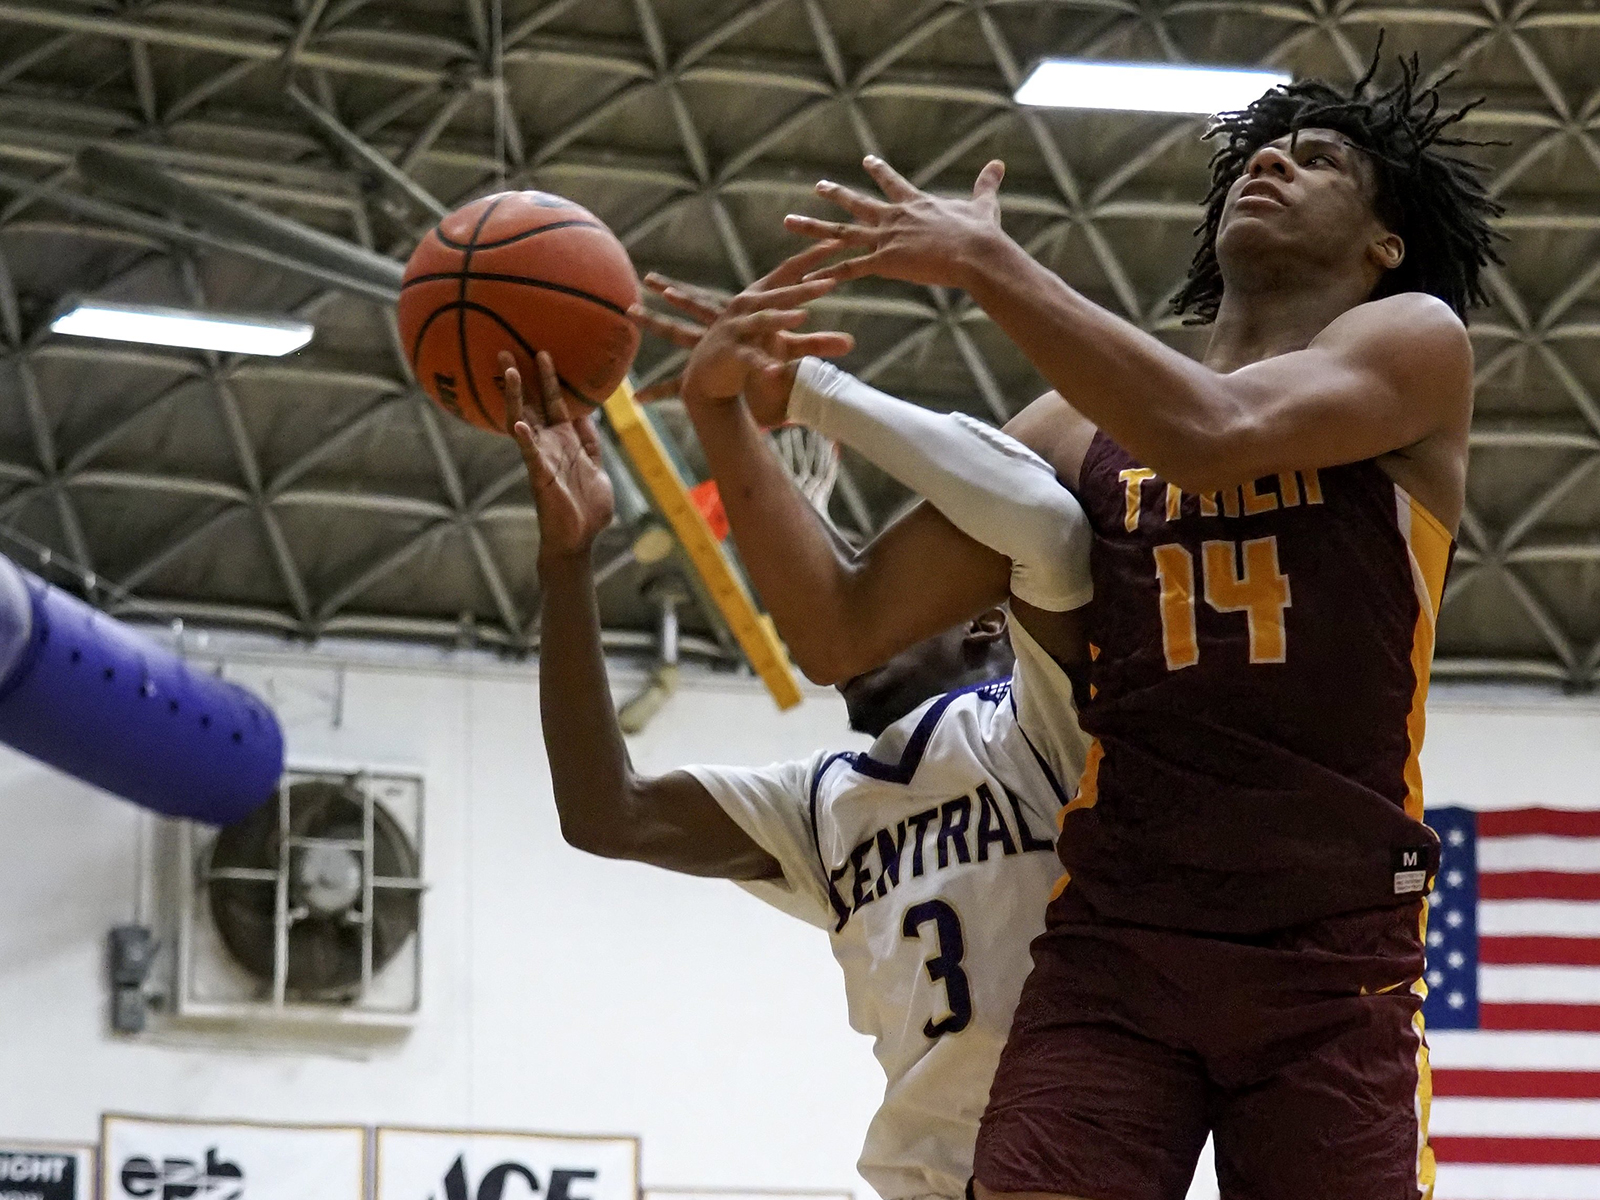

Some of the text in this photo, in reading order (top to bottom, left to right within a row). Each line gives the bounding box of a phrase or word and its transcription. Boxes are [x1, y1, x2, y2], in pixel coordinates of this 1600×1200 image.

[1153, 535, 1292, 671] 14
[828, 781, 1056, 933] CENTRAL
[1403, 851, 1418, 867] M
[902, 899, 973, 1039] 3
